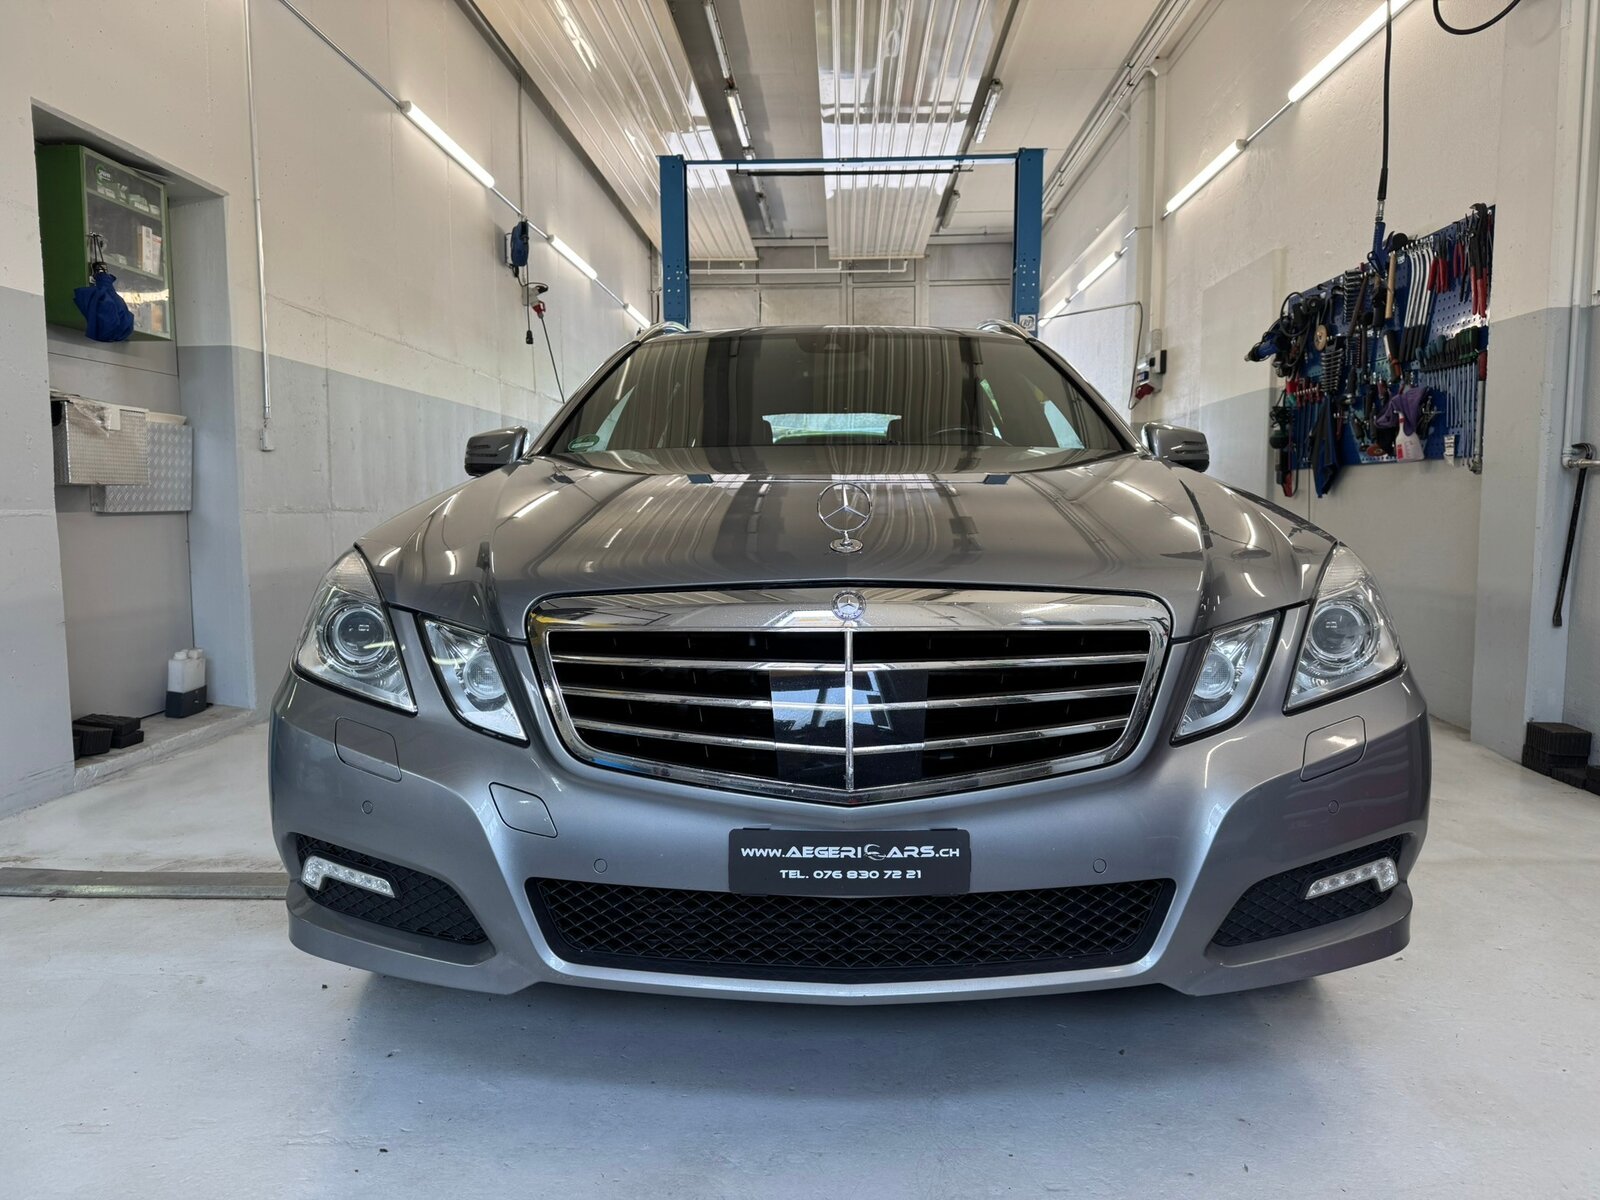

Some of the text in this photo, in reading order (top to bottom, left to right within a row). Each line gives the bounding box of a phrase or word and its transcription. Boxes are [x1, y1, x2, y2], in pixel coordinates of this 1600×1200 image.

[779, 869, 922, 880] TEL. 076 830 72 21
